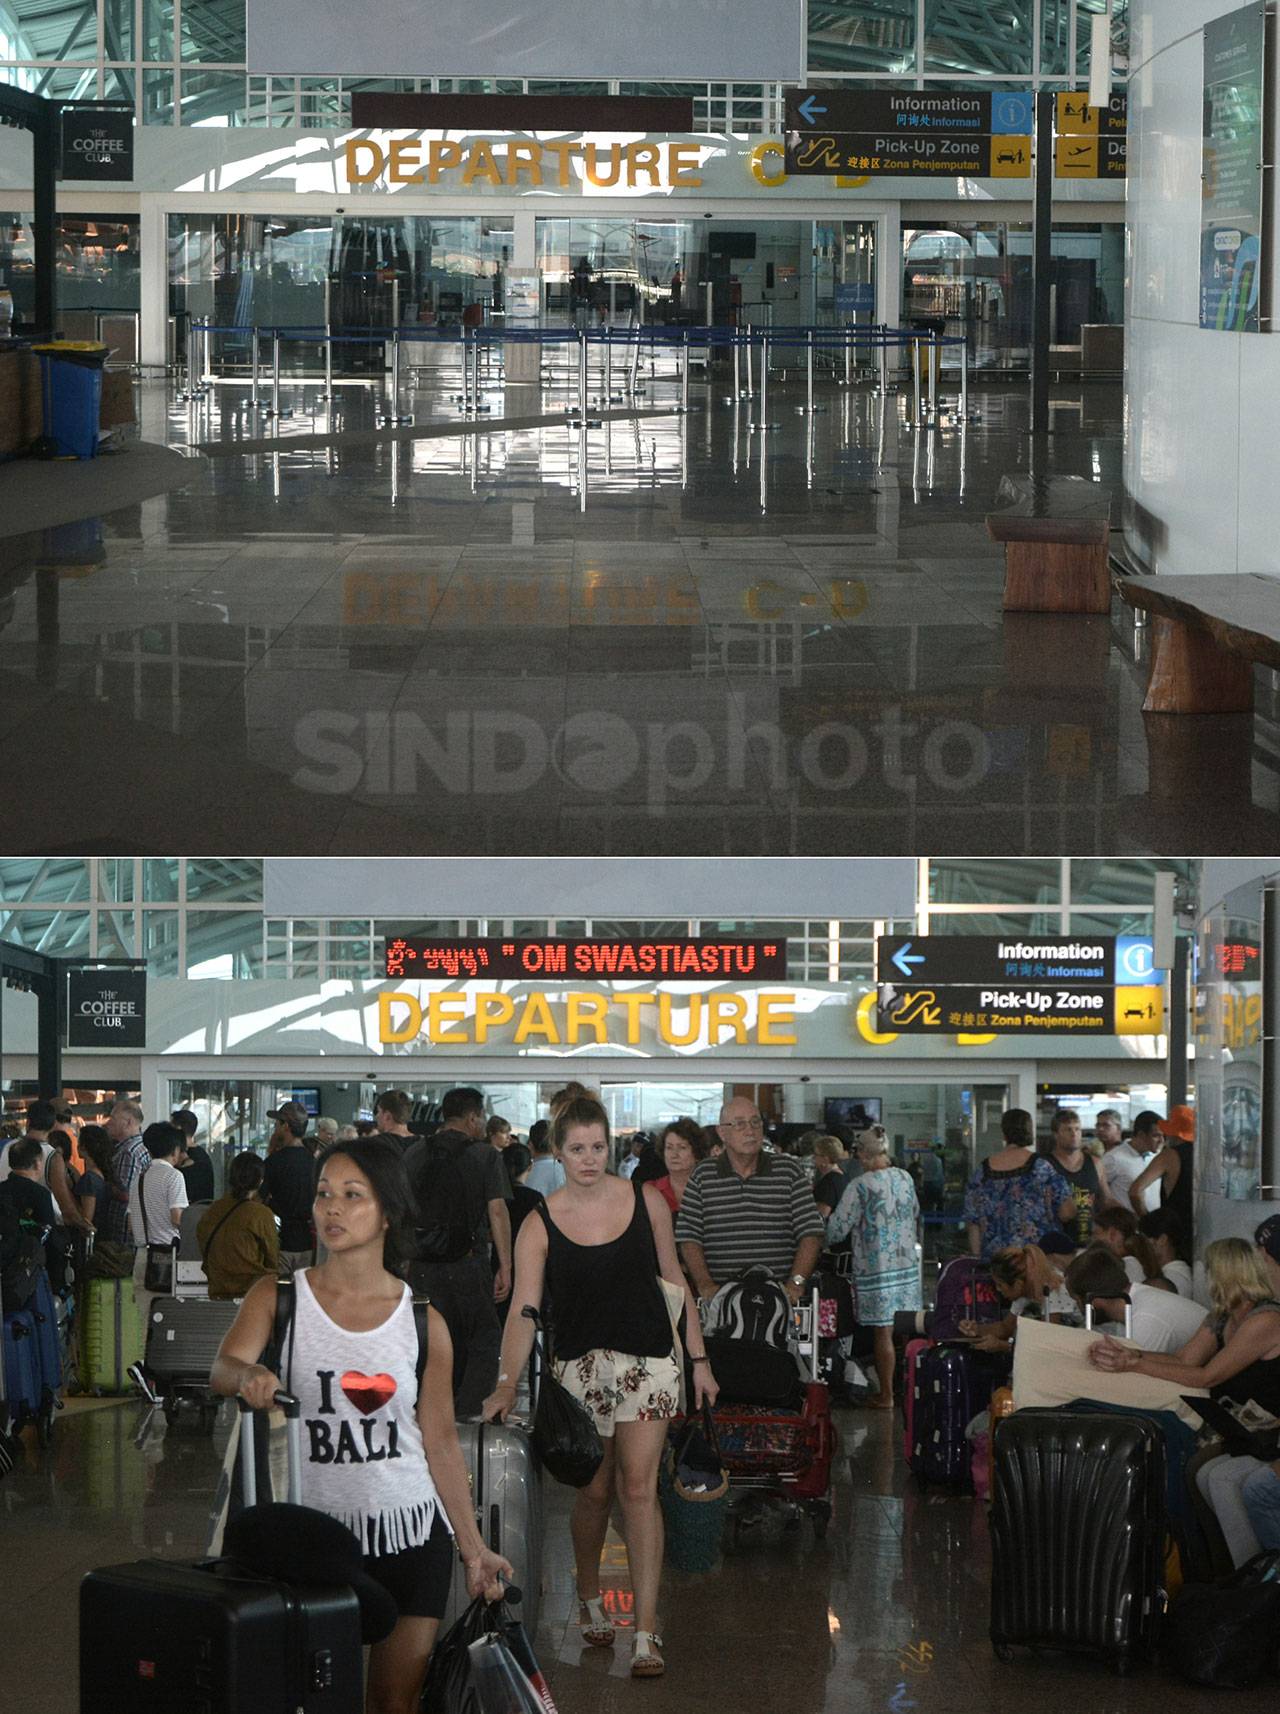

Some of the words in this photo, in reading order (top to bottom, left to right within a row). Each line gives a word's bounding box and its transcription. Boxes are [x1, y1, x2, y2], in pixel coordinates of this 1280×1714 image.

[890, 97, 981, 111] Information
[897, 113, 930, 127] 问询处
[932, 116, 981, 127] Informasi
[89, 130, 107, 138] THE
[73, 139, 124, 151] COFFEE
[875, 139, 935, 156] Pick-Up
[940, 141, 980, 154] Zone
[85, 153, 111, 162] CLUB
[346, 139, 703, 189] DEPARTURE
[847, 156, 881, 169] 迎接区
[883, 159, 909, 169] Zona
[912, 159, 980, 171] Penjemputan
[998, 943, 1104, 959] Information
[523, 946, 567, 973] OM
[574, 945, 756, 973] SWASTIASTU
[1047, 966, 1104, 977] Informasi
[98, 990, 118, 1000] THE
[980, 992, 1052, 1011] Pick-Up
[1056, 993, 1104, 1008] Zone
[80, 1001, 135, 1014] COFFEE
[93, 1016, 122, 1027] CLUB
[378, 991, 798, 1045] DEPARTURE
[990, 1014, 1021, 1026] Zona
[1024, 1014, 1103, 1028] Penjemputan
[316, 1370, 336, 1414] I
[305, 1417, 402, 1464] BALI
